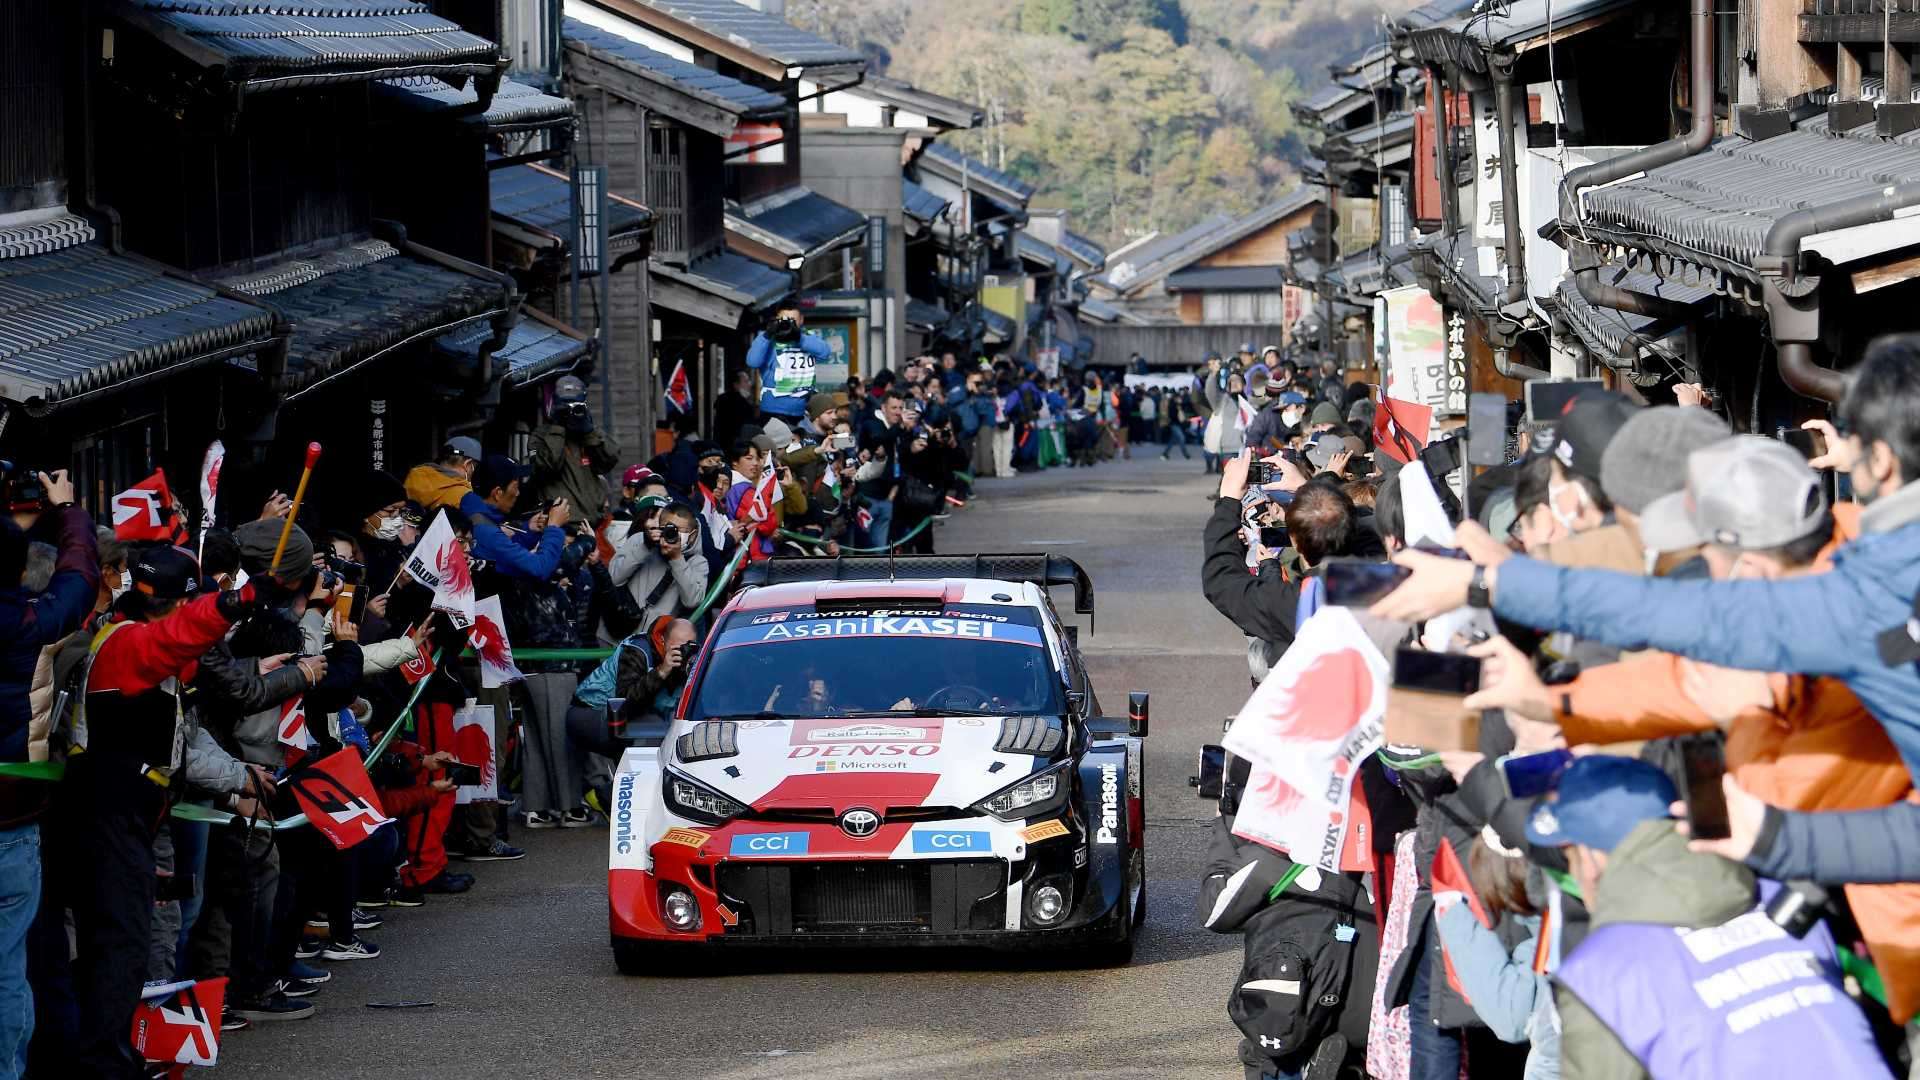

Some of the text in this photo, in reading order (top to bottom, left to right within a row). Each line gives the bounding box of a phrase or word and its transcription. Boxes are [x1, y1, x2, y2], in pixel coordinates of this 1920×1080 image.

[790, 355, 815, 369] 220
[794, 611, 868, 619] TOYOTA
[870, 609, 941, 618] GAZOO
[945, 611, 1008, 622] Racing
[787, 744, 940, 758] DENSO
[840, 761, 908, 769] Microsoft
[749, 836, 789, 850] CCi
[931, 834, 971, 848] CCi
